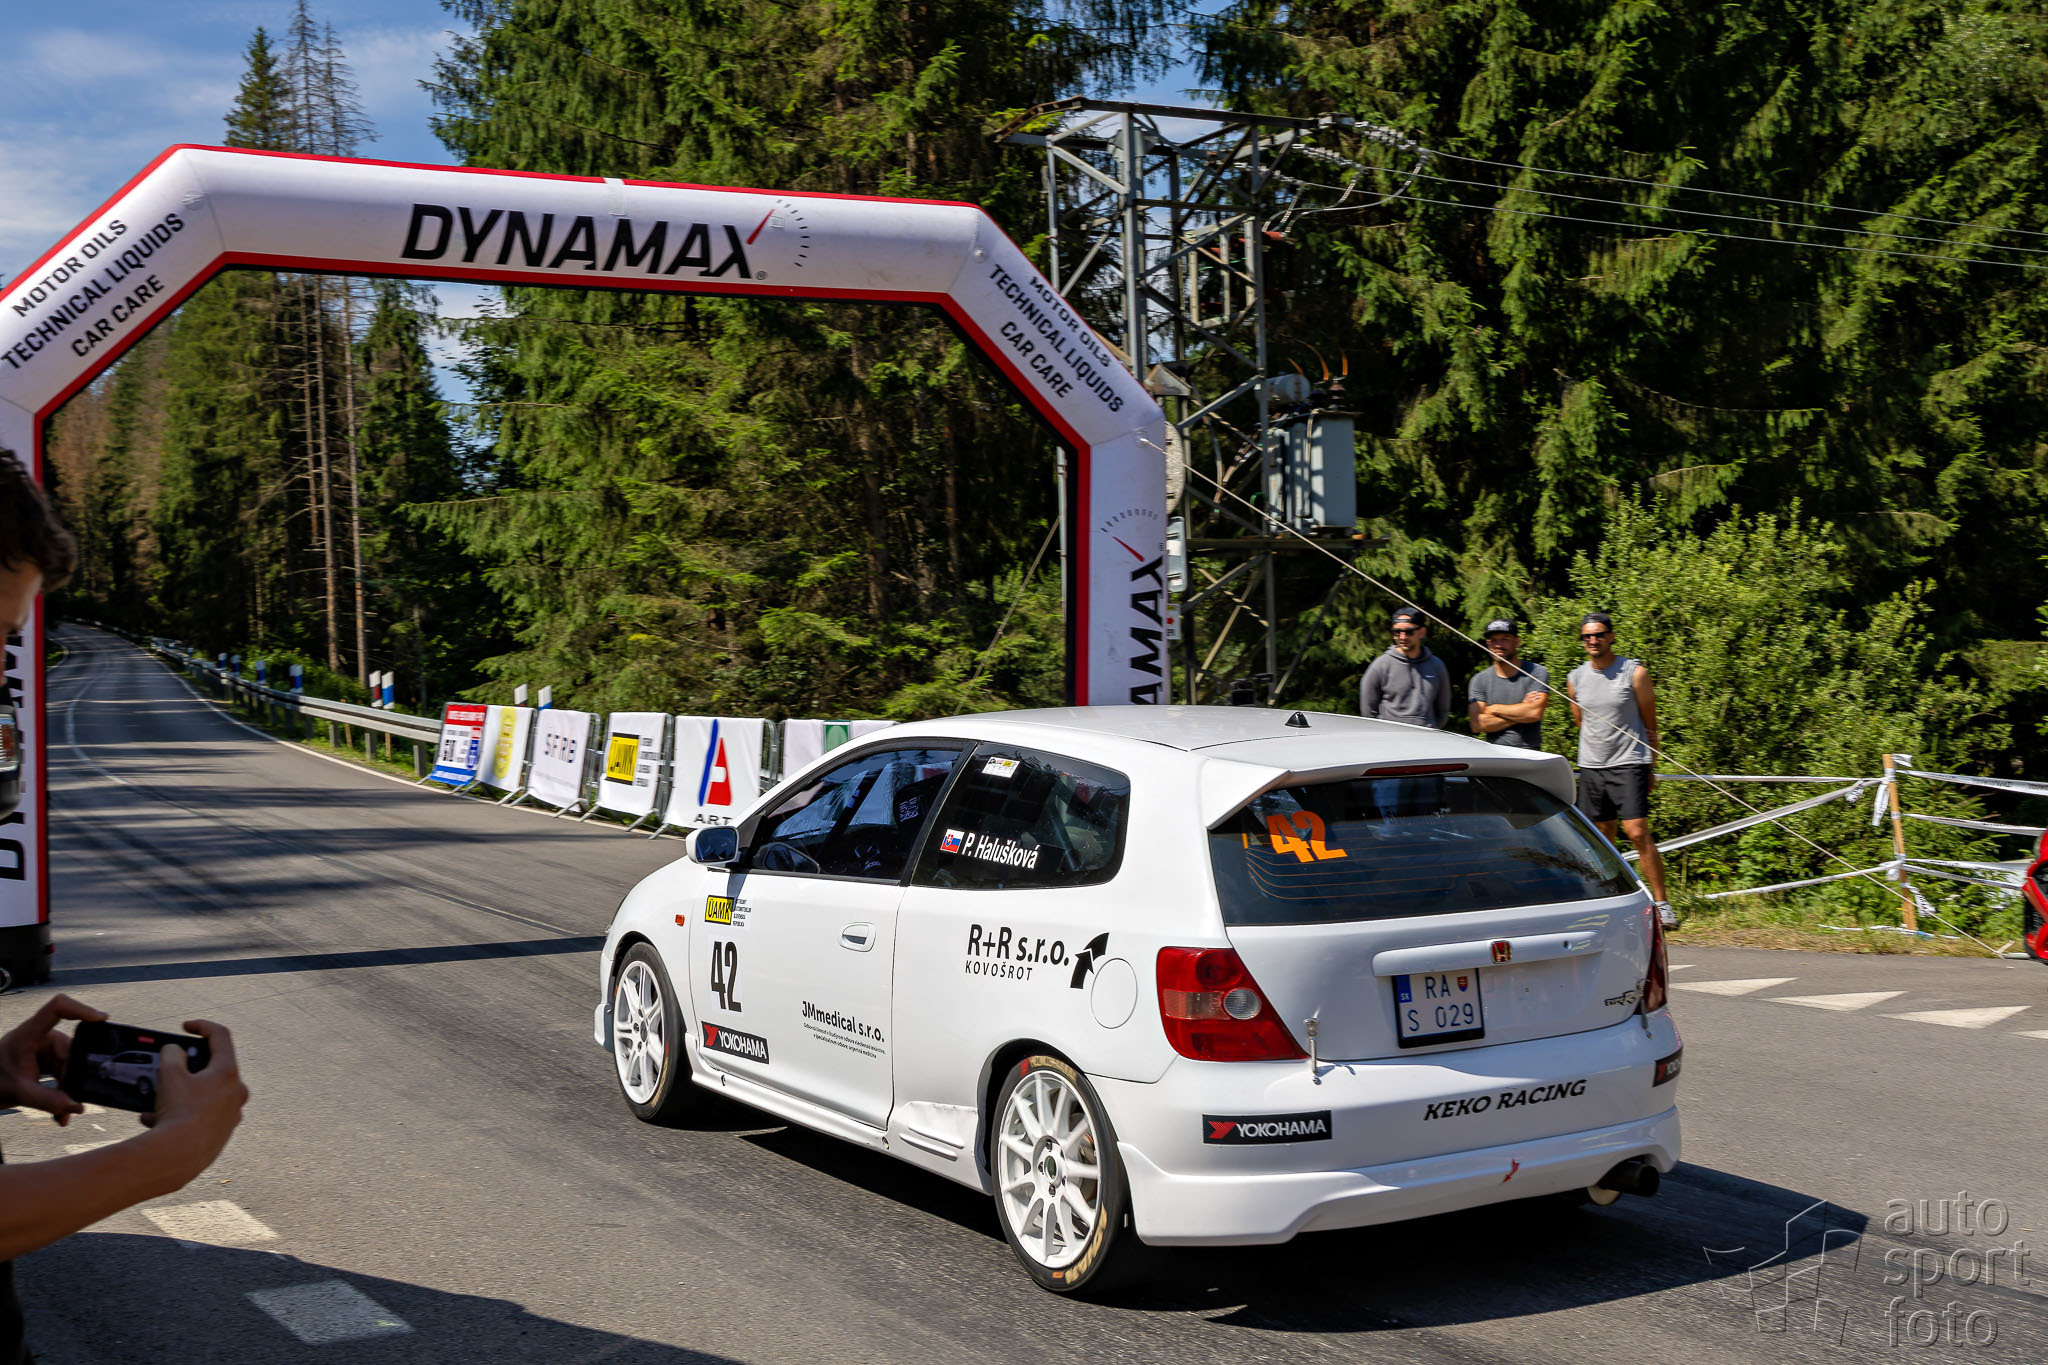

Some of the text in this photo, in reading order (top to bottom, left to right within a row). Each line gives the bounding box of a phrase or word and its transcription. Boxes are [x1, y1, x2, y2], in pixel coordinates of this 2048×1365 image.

[401, 203, 752, 279] DYNAMAX
[0, 213, 185, 369] TECHNICAL LIQUIDS
[12, 219, 128, 317] MOTOR OILS
[71, 274, 165, 357] CAR CARE
[989, 264, 1124, 412] TECHNICAL LIQUIDS
[1029, 276, 1113, 368] MOTOR OILS
[1000, 321, 1074, 398] CAR CARE
[962, 832, 1041, 869] P. Halušková
[1266, 811, 1348, 863] 42
[967, 924, 1070, 966] R+R s.r.o.
[710, 941, 742, 1012] 42
[965, 960, 1033, 981] KOVOŠROT
[1425, 975, 1451, 999] RA
[802, 1000, 857, 1034] JMmedical
[858, 1022, 885, 1043] s.r.o.
[1407, 1003, 1475, 1031] S 029
[718, 1031, 767, 1059] YOKOHAMA
[1424, 1079, 1587, 1121] KEKO RACING
[1235, 1119, 1327, 1137] YOKOHAMA
